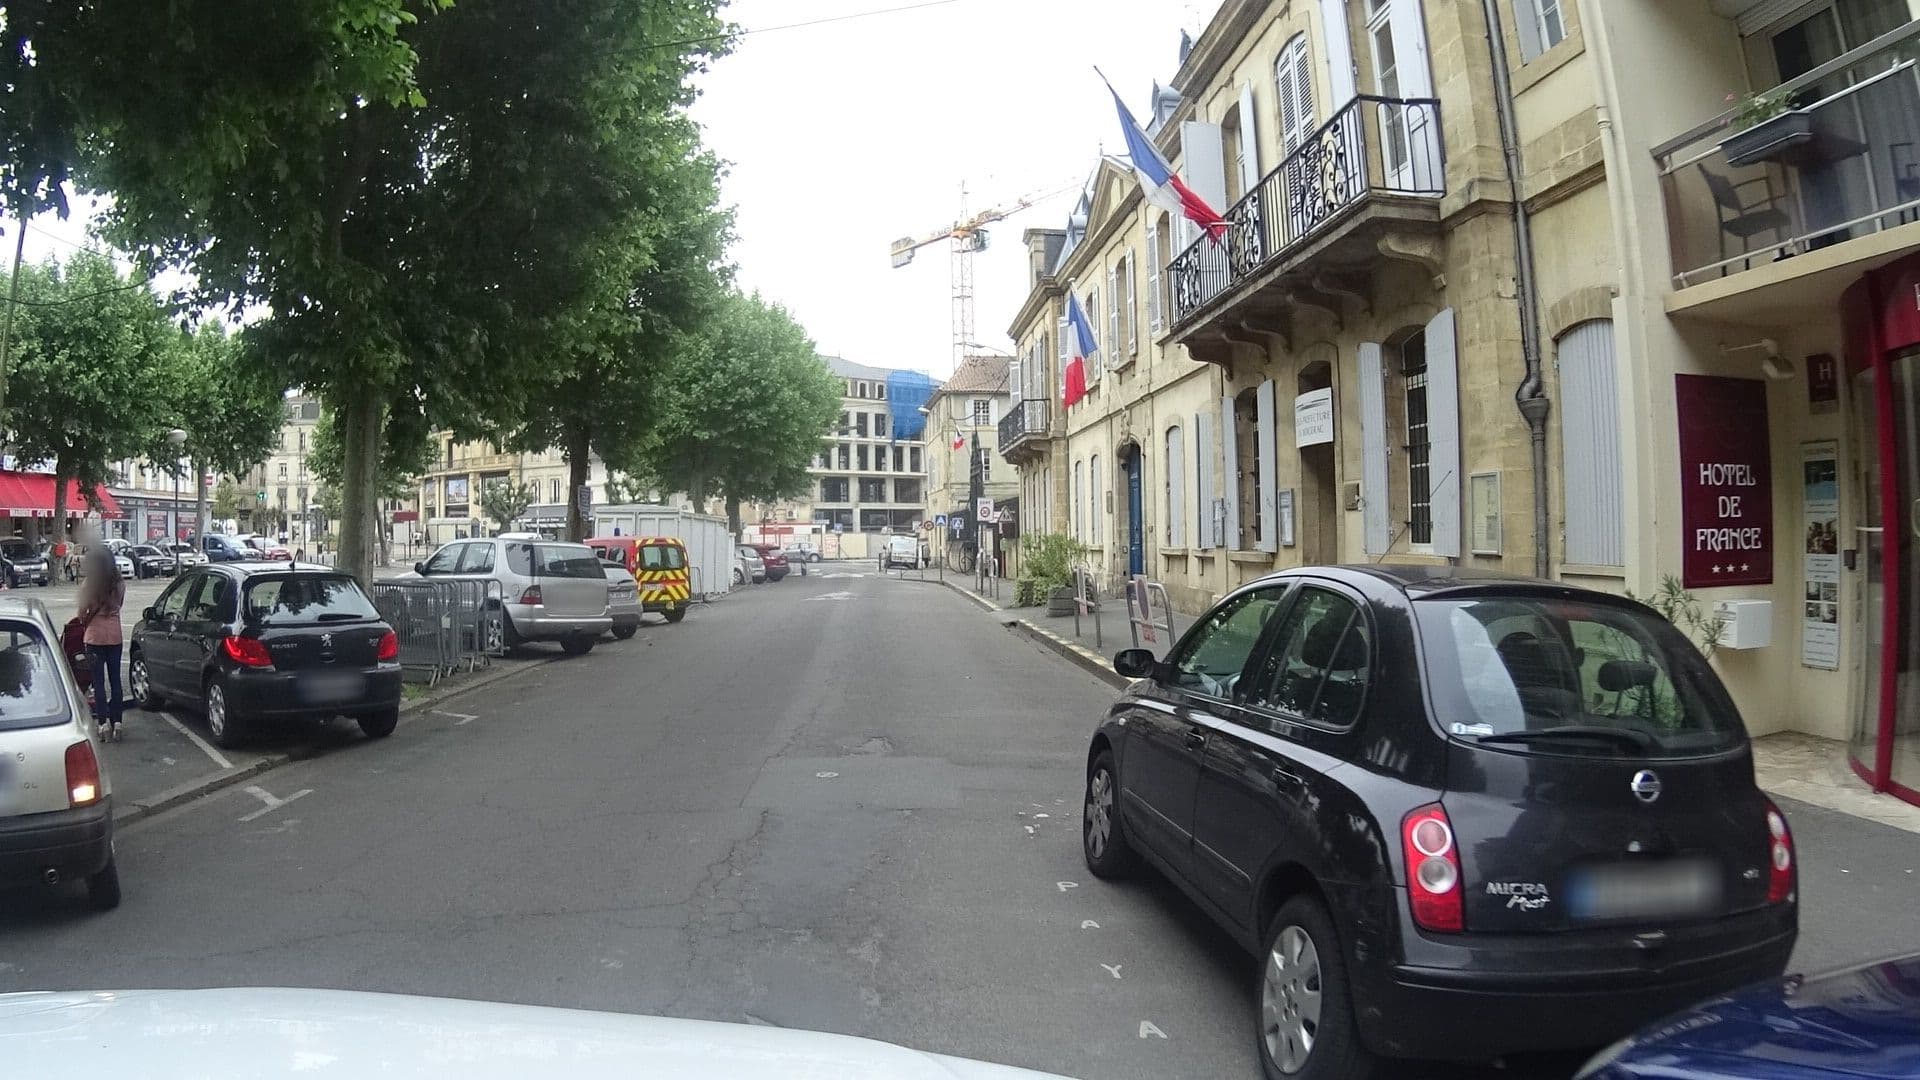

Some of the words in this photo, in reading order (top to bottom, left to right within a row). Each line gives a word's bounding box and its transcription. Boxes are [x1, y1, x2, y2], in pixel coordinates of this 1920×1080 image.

[1700, 463, 1757, 486] HOTEL
[1718, 495, 1742, 518] DE
[1696, 527, 1762, 552] FRANCE
[1486, 881, 1550, 896] MICRA
